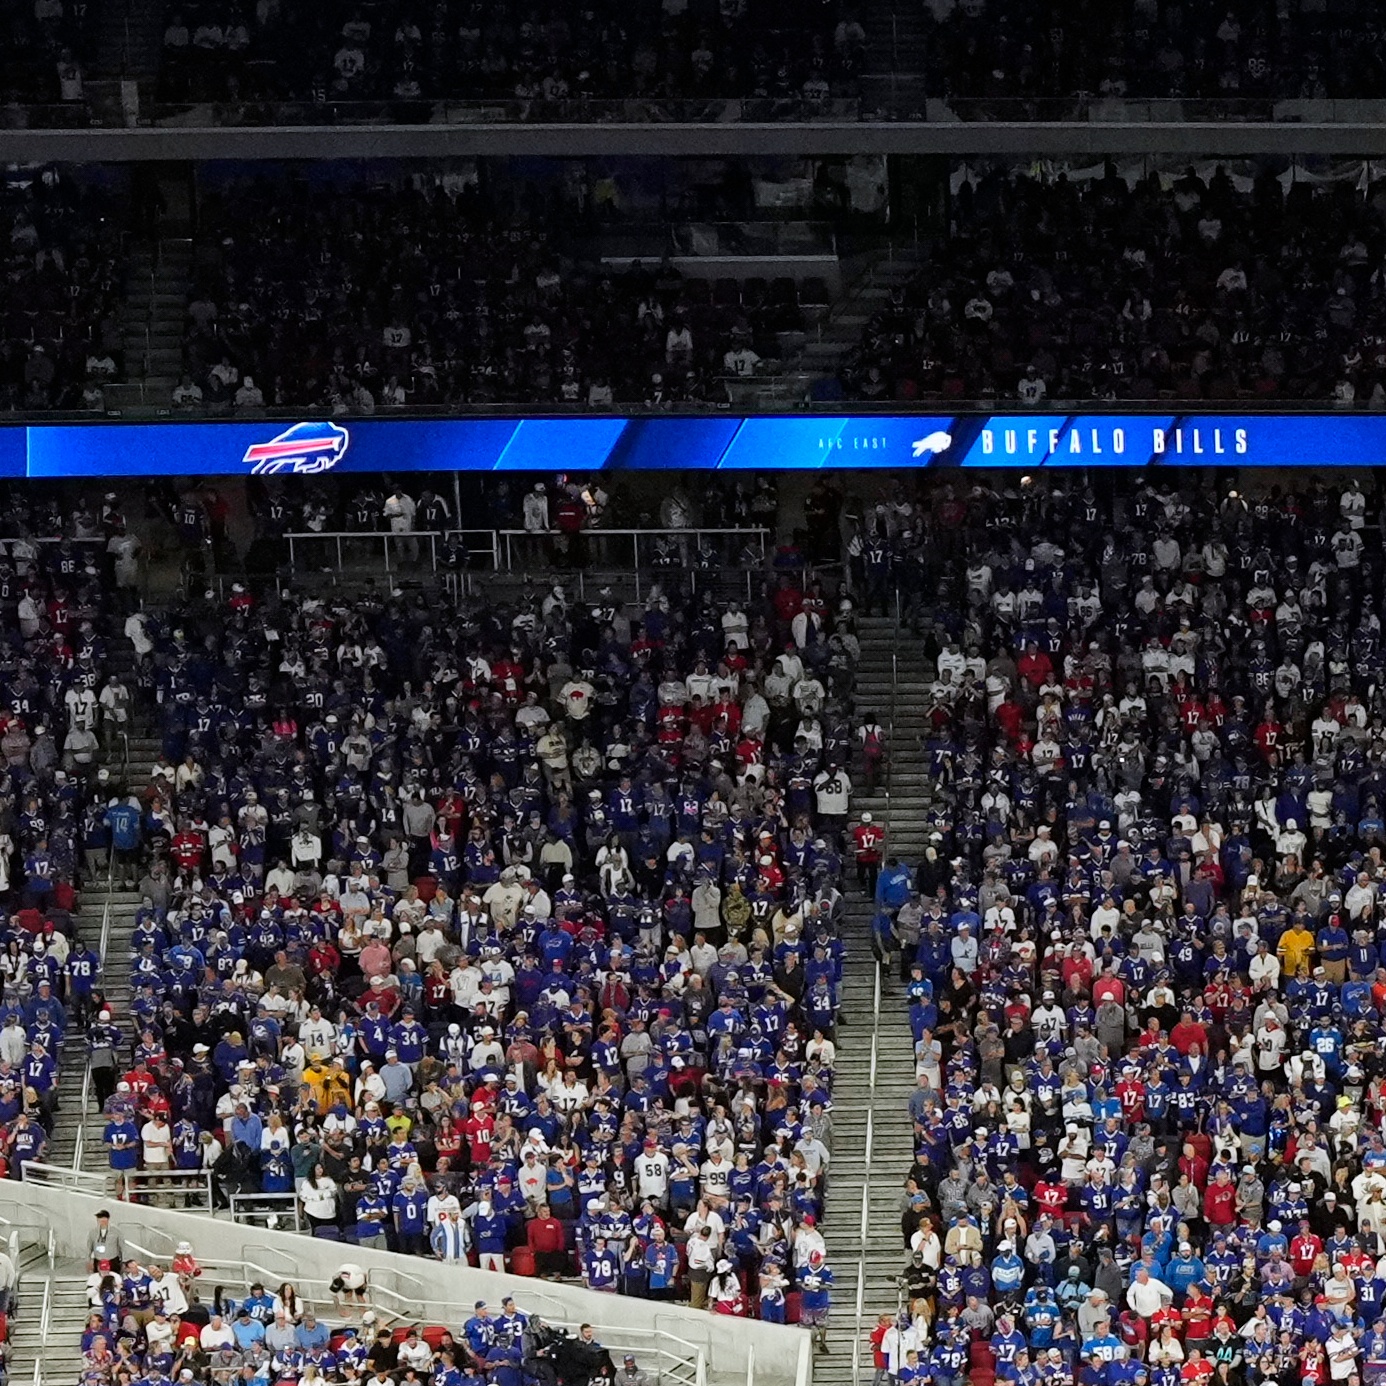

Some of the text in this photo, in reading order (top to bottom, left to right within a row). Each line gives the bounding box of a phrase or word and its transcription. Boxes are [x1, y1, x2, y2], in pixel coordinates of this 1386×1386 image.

[818, 437, 888, 449] AFC EAST
[981, 428, 1248, 455] BUFFALO BILLS
[271, 507, 282, 519] 17
[358, 511, 368, 522] 17
[1086, 508, 1096, 520] 17
[870, 550, 882, 563] 17
[56, 610, 68, 623] 17
[1188, 712, 1199, 724] 17
[198, 719, 210, 731] 17
[1072, 754, 1084, 768] 17
[862, 833, 874, 848] 17
